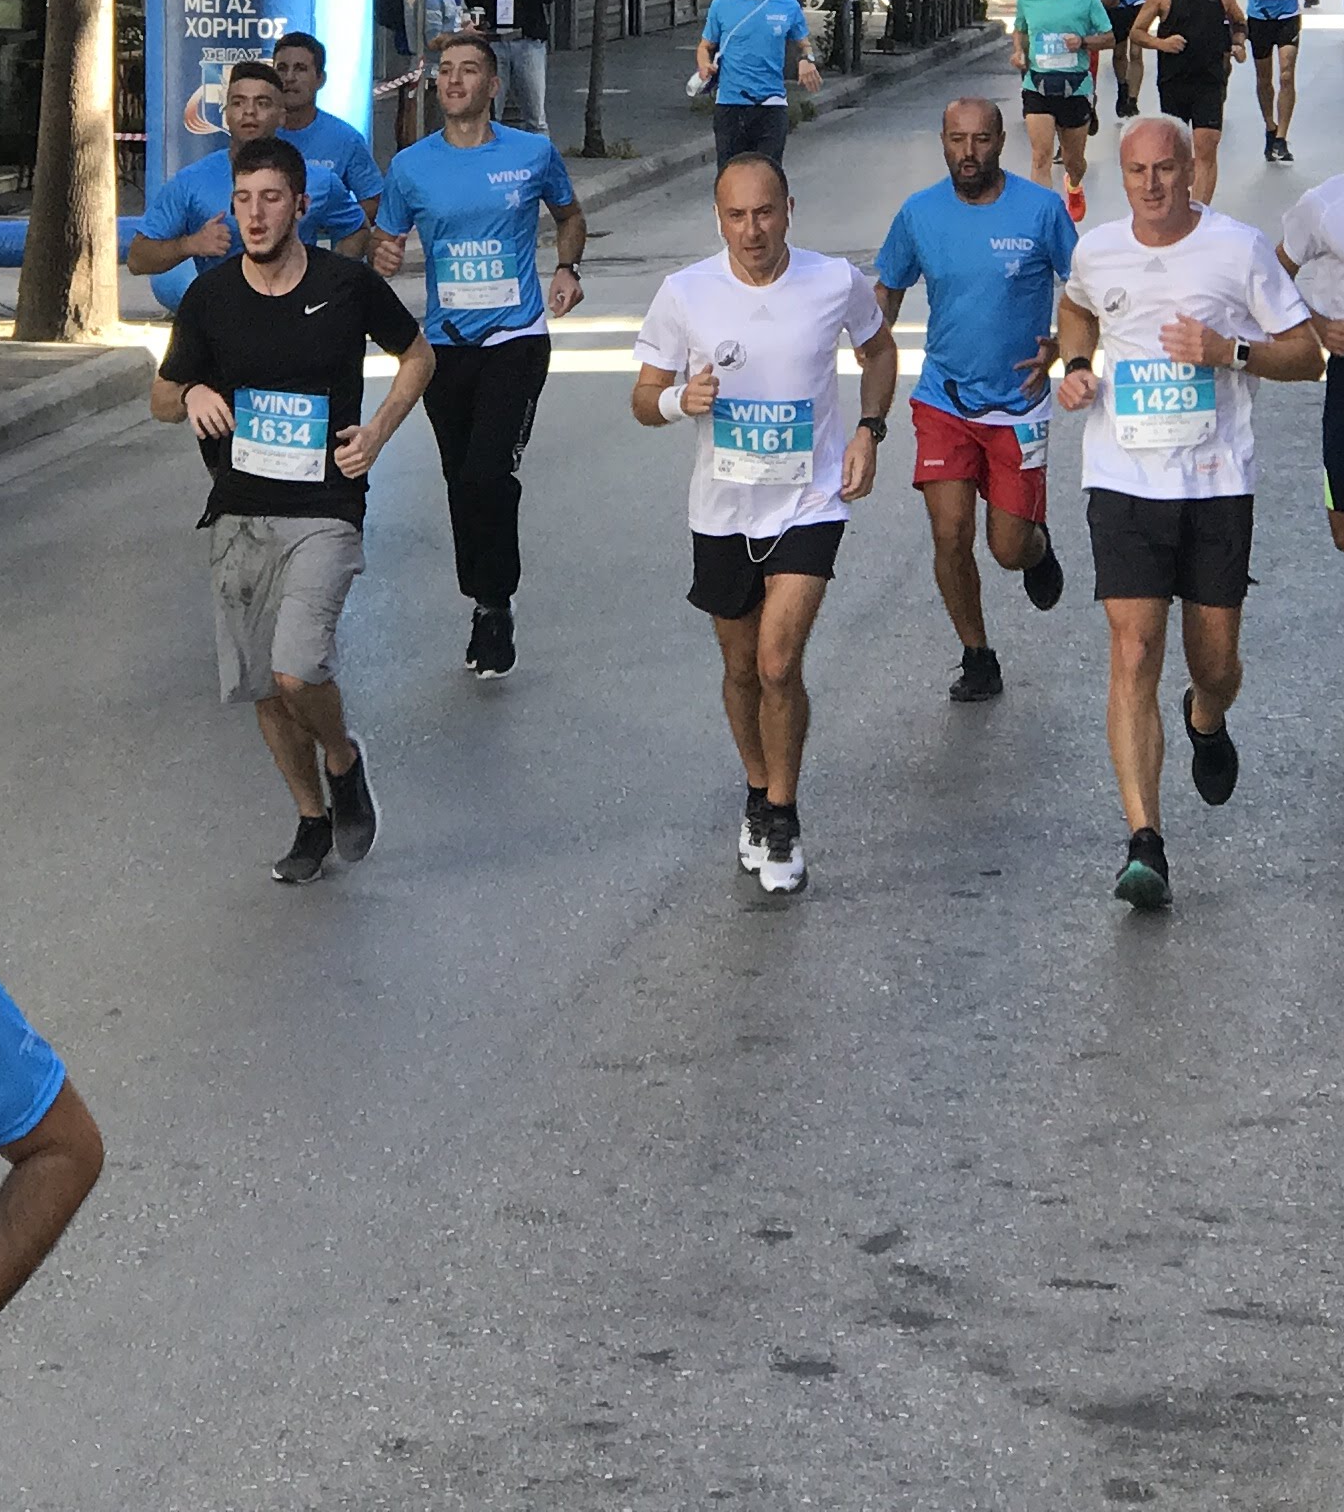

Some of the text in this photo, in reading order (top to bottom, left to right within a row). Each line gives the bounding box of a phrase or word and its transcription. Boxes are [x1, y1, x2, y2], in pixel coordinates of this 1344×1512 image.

[184, 17, 288, 39] ΧΟΡΗΓΟΣ
[202, 47, 263, 62] ΣΕΓΑΣ
[487, 169, 532, 184] WIND
[447, 239, 502, 257] WIND
[990, 238, 1035, 251] WIND
[449, 259, 505, 281] 1618
[1129, 362, 1196, 383] WIND
[249, 391, 313, 416] WIND
[1132, 385, 1198, 412] 1429
[729, 402, 797, 423] WIND
[248, 416, 311, 446] 1634
[730, 426, 794, 451] 1161
